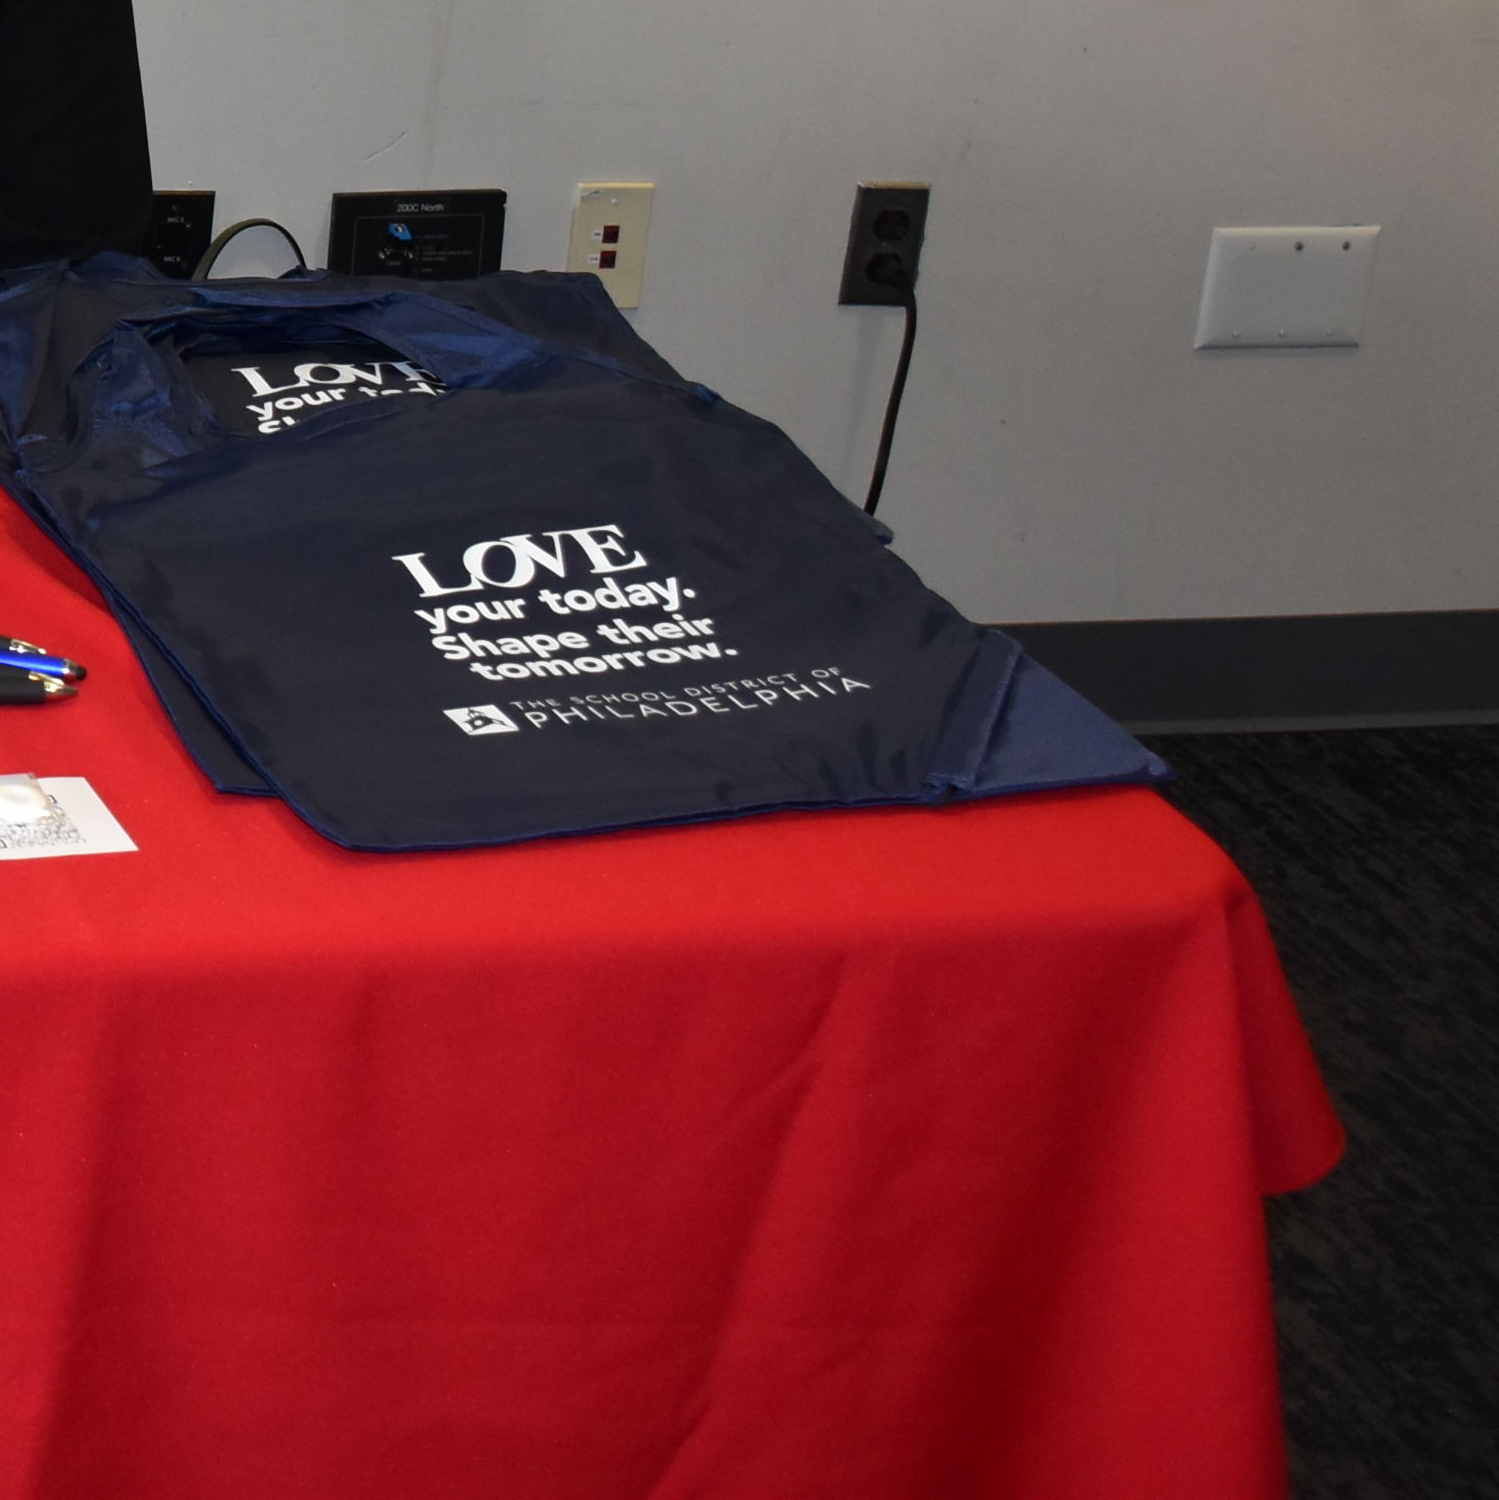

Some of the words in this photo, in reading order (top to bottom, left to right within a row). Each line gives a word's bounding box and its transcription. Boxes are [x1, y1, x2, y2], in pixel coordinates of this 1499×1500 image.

[396, 203, 419, 212] 200C
[421, 203, 443, 212] North
[246, 388, 347, 421] your
[392, 524, 647, 598] LOVE
[414, 595, 526, 635] your
[538, 577, 697, 616] today.
[431, 629, 588, 661] Shape
[596, 613, 715, 648] their
[469, 638, 738, 681] tomorrow.
[510, 699, 564, 713] THE
[570, 688, 676, 707] SCHOOL
[683, 671, 797, 698] DISTRICT
[811, 666, 842, 680] OF
[523, 674, 872, 730] PHILADELPHIA
